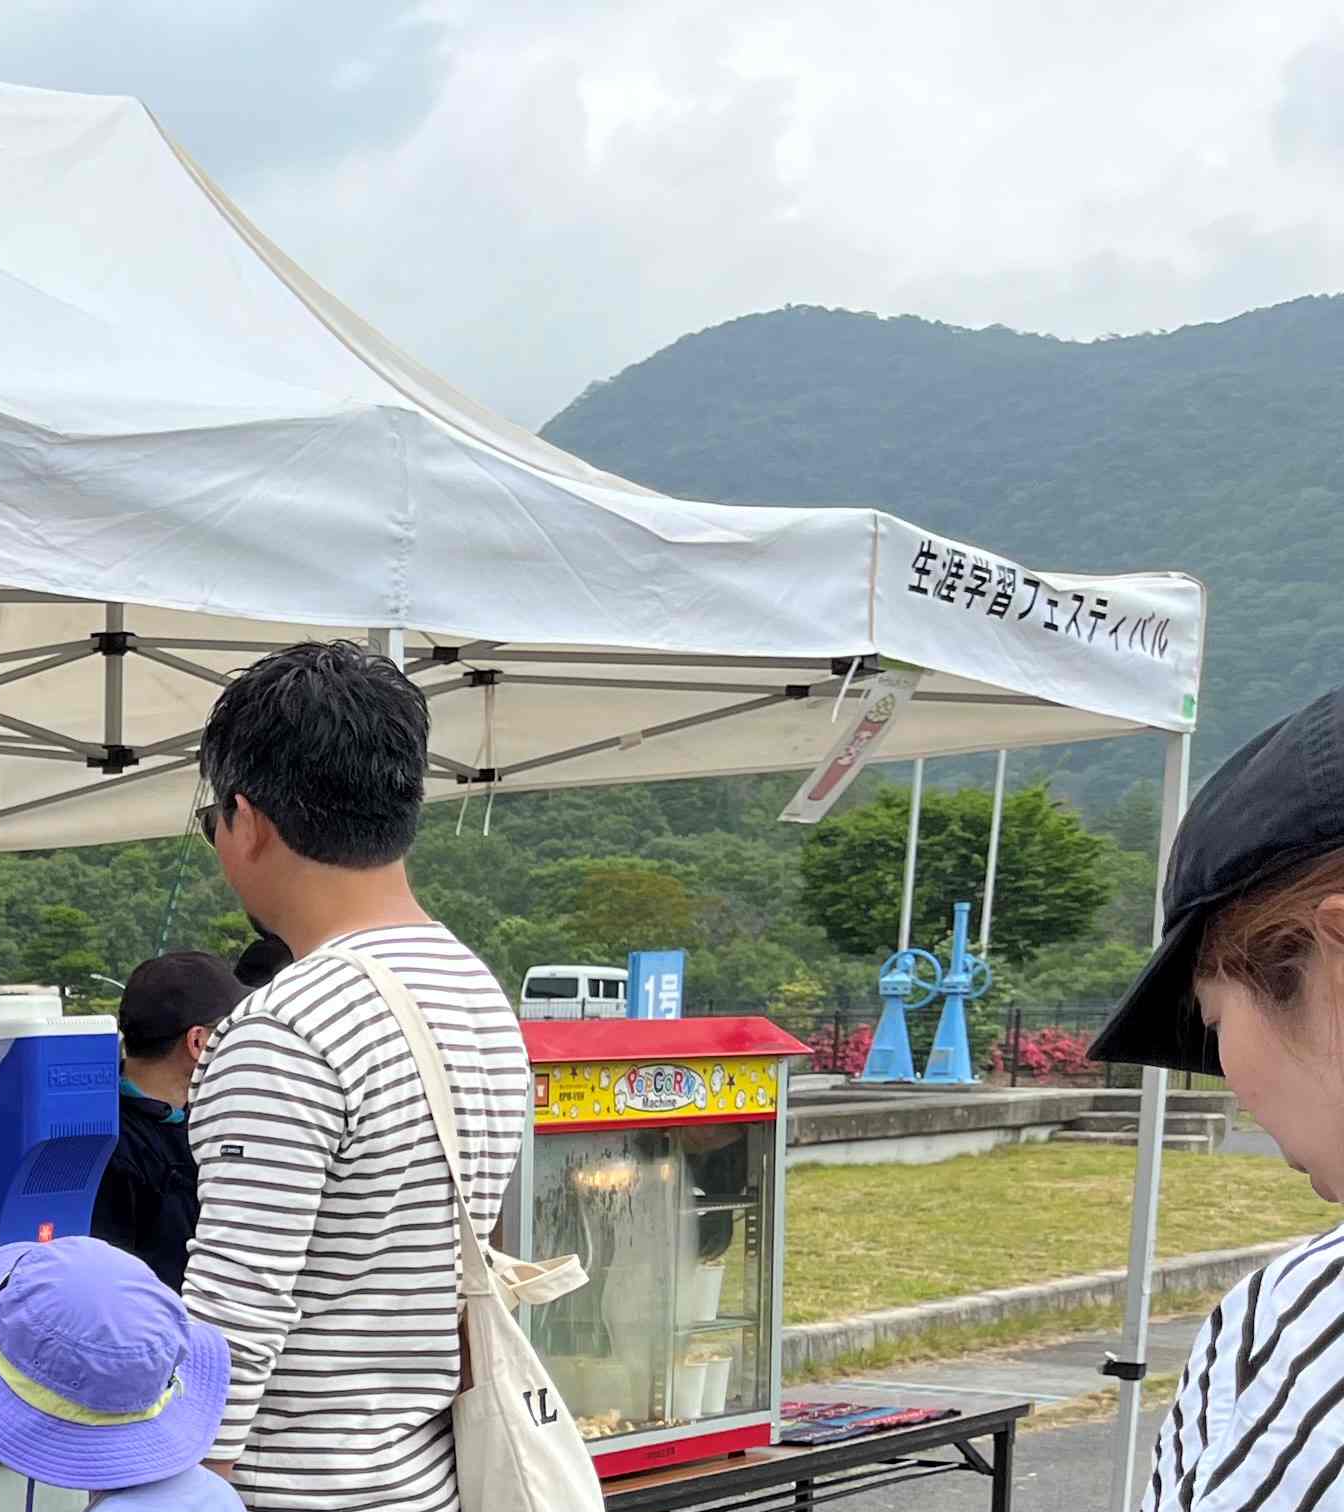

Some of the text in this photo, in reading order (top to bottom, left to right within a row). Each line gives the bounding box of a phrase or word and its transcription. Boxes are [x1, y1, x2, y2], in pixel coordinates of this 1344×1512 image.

[908, 539, 1170, 659] 生涯学習フェスティバル
